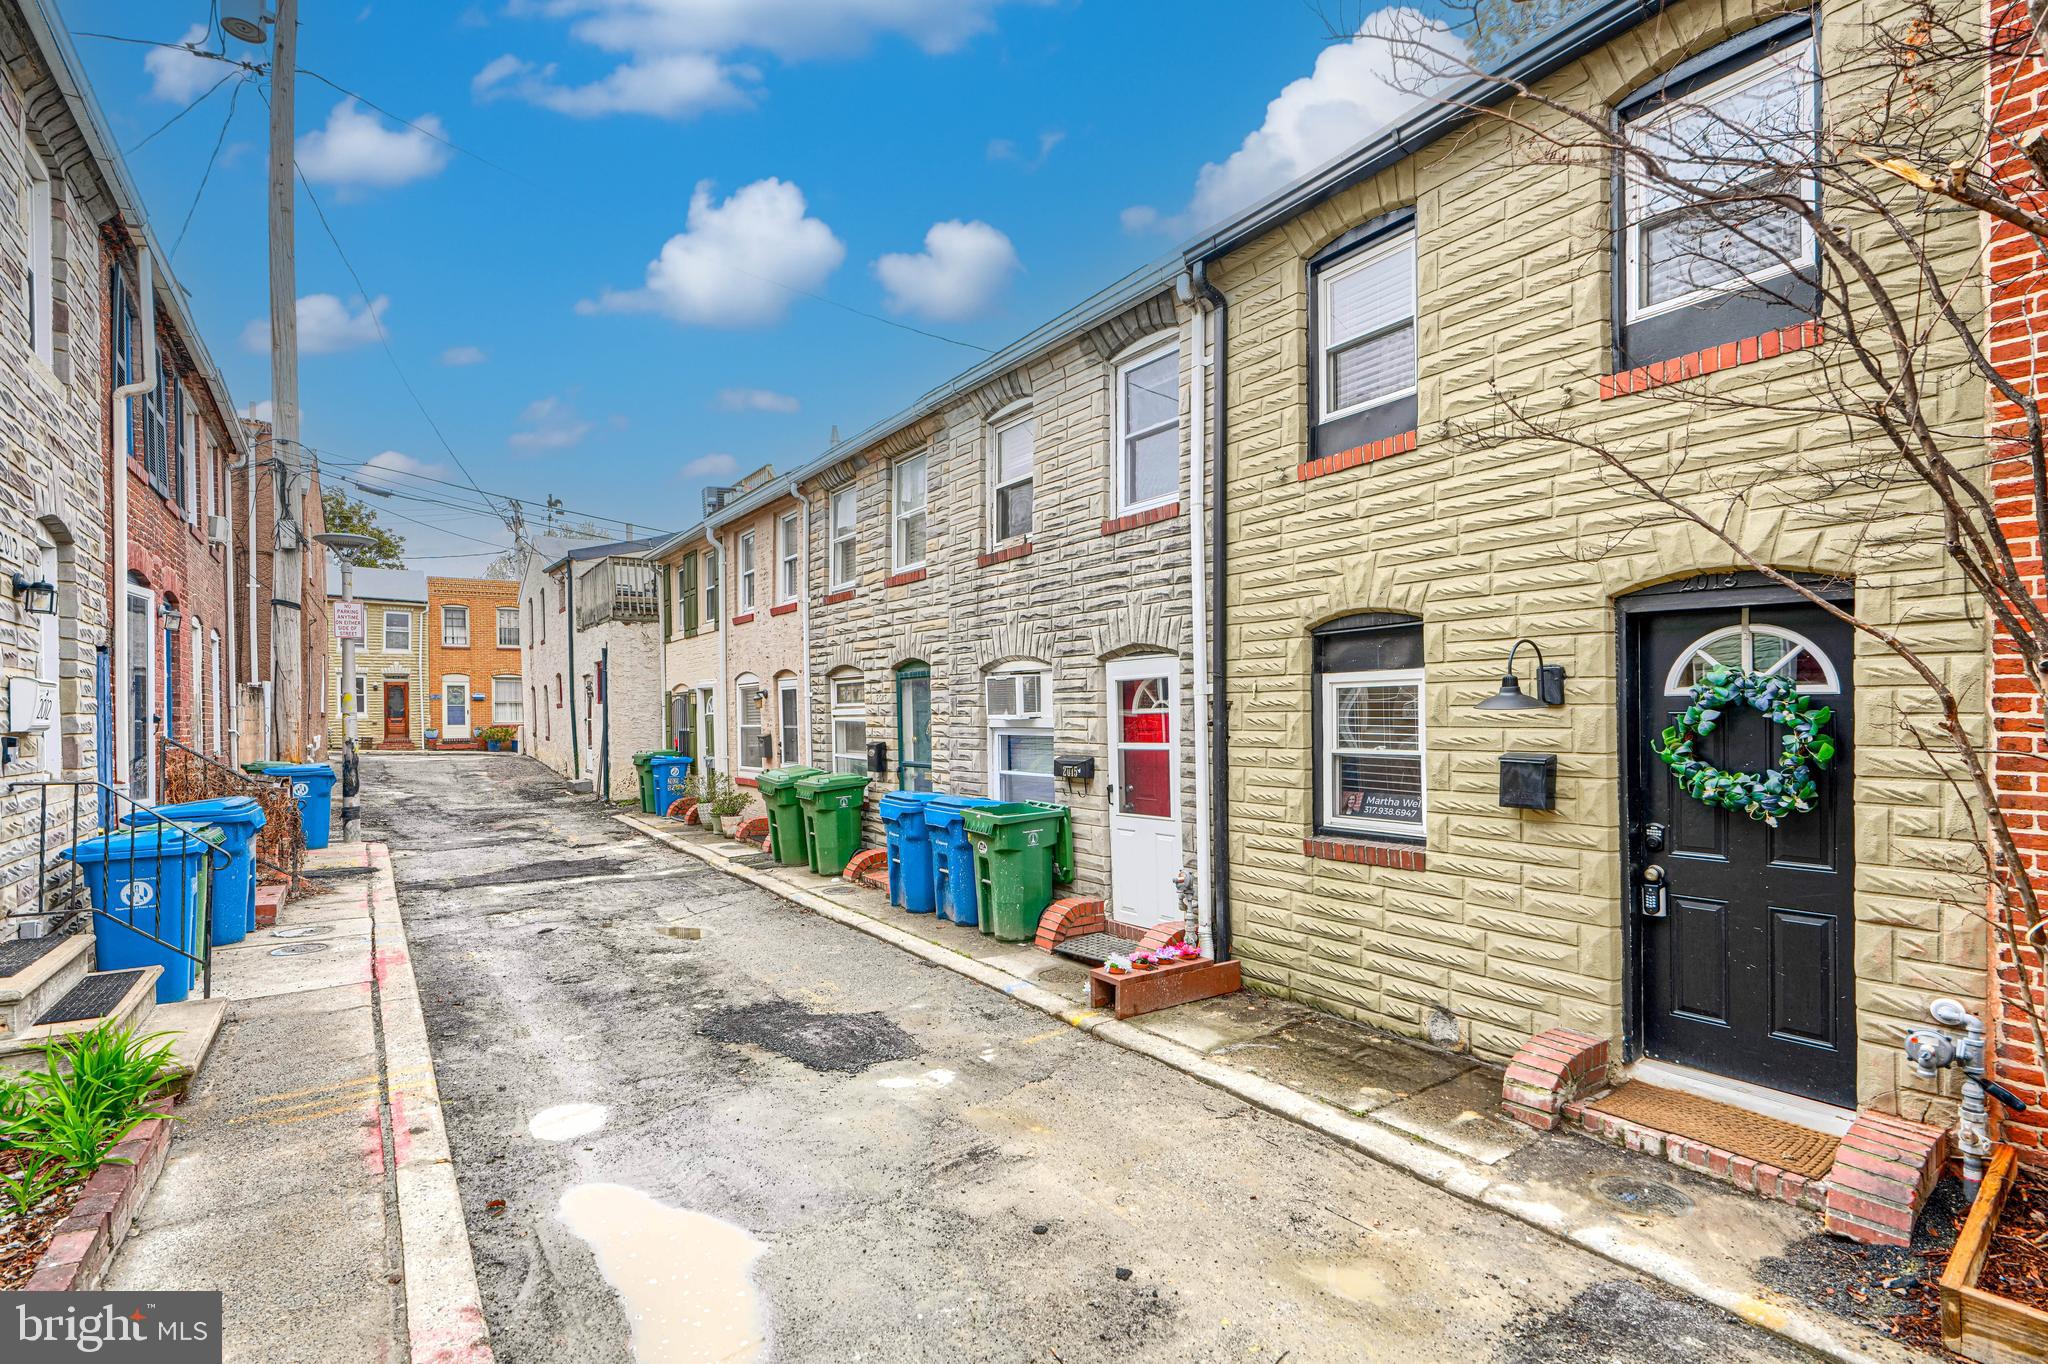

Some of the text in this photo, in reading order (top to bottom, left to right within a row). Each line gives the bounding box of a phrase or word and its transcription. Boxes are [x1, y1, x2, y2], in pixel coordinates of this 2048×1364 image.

[1063, 765, 1078, 777] 2015
[1366, 796, 1400, 807] Martha
[1363, 805, 1418, 817] 317.938.6947
